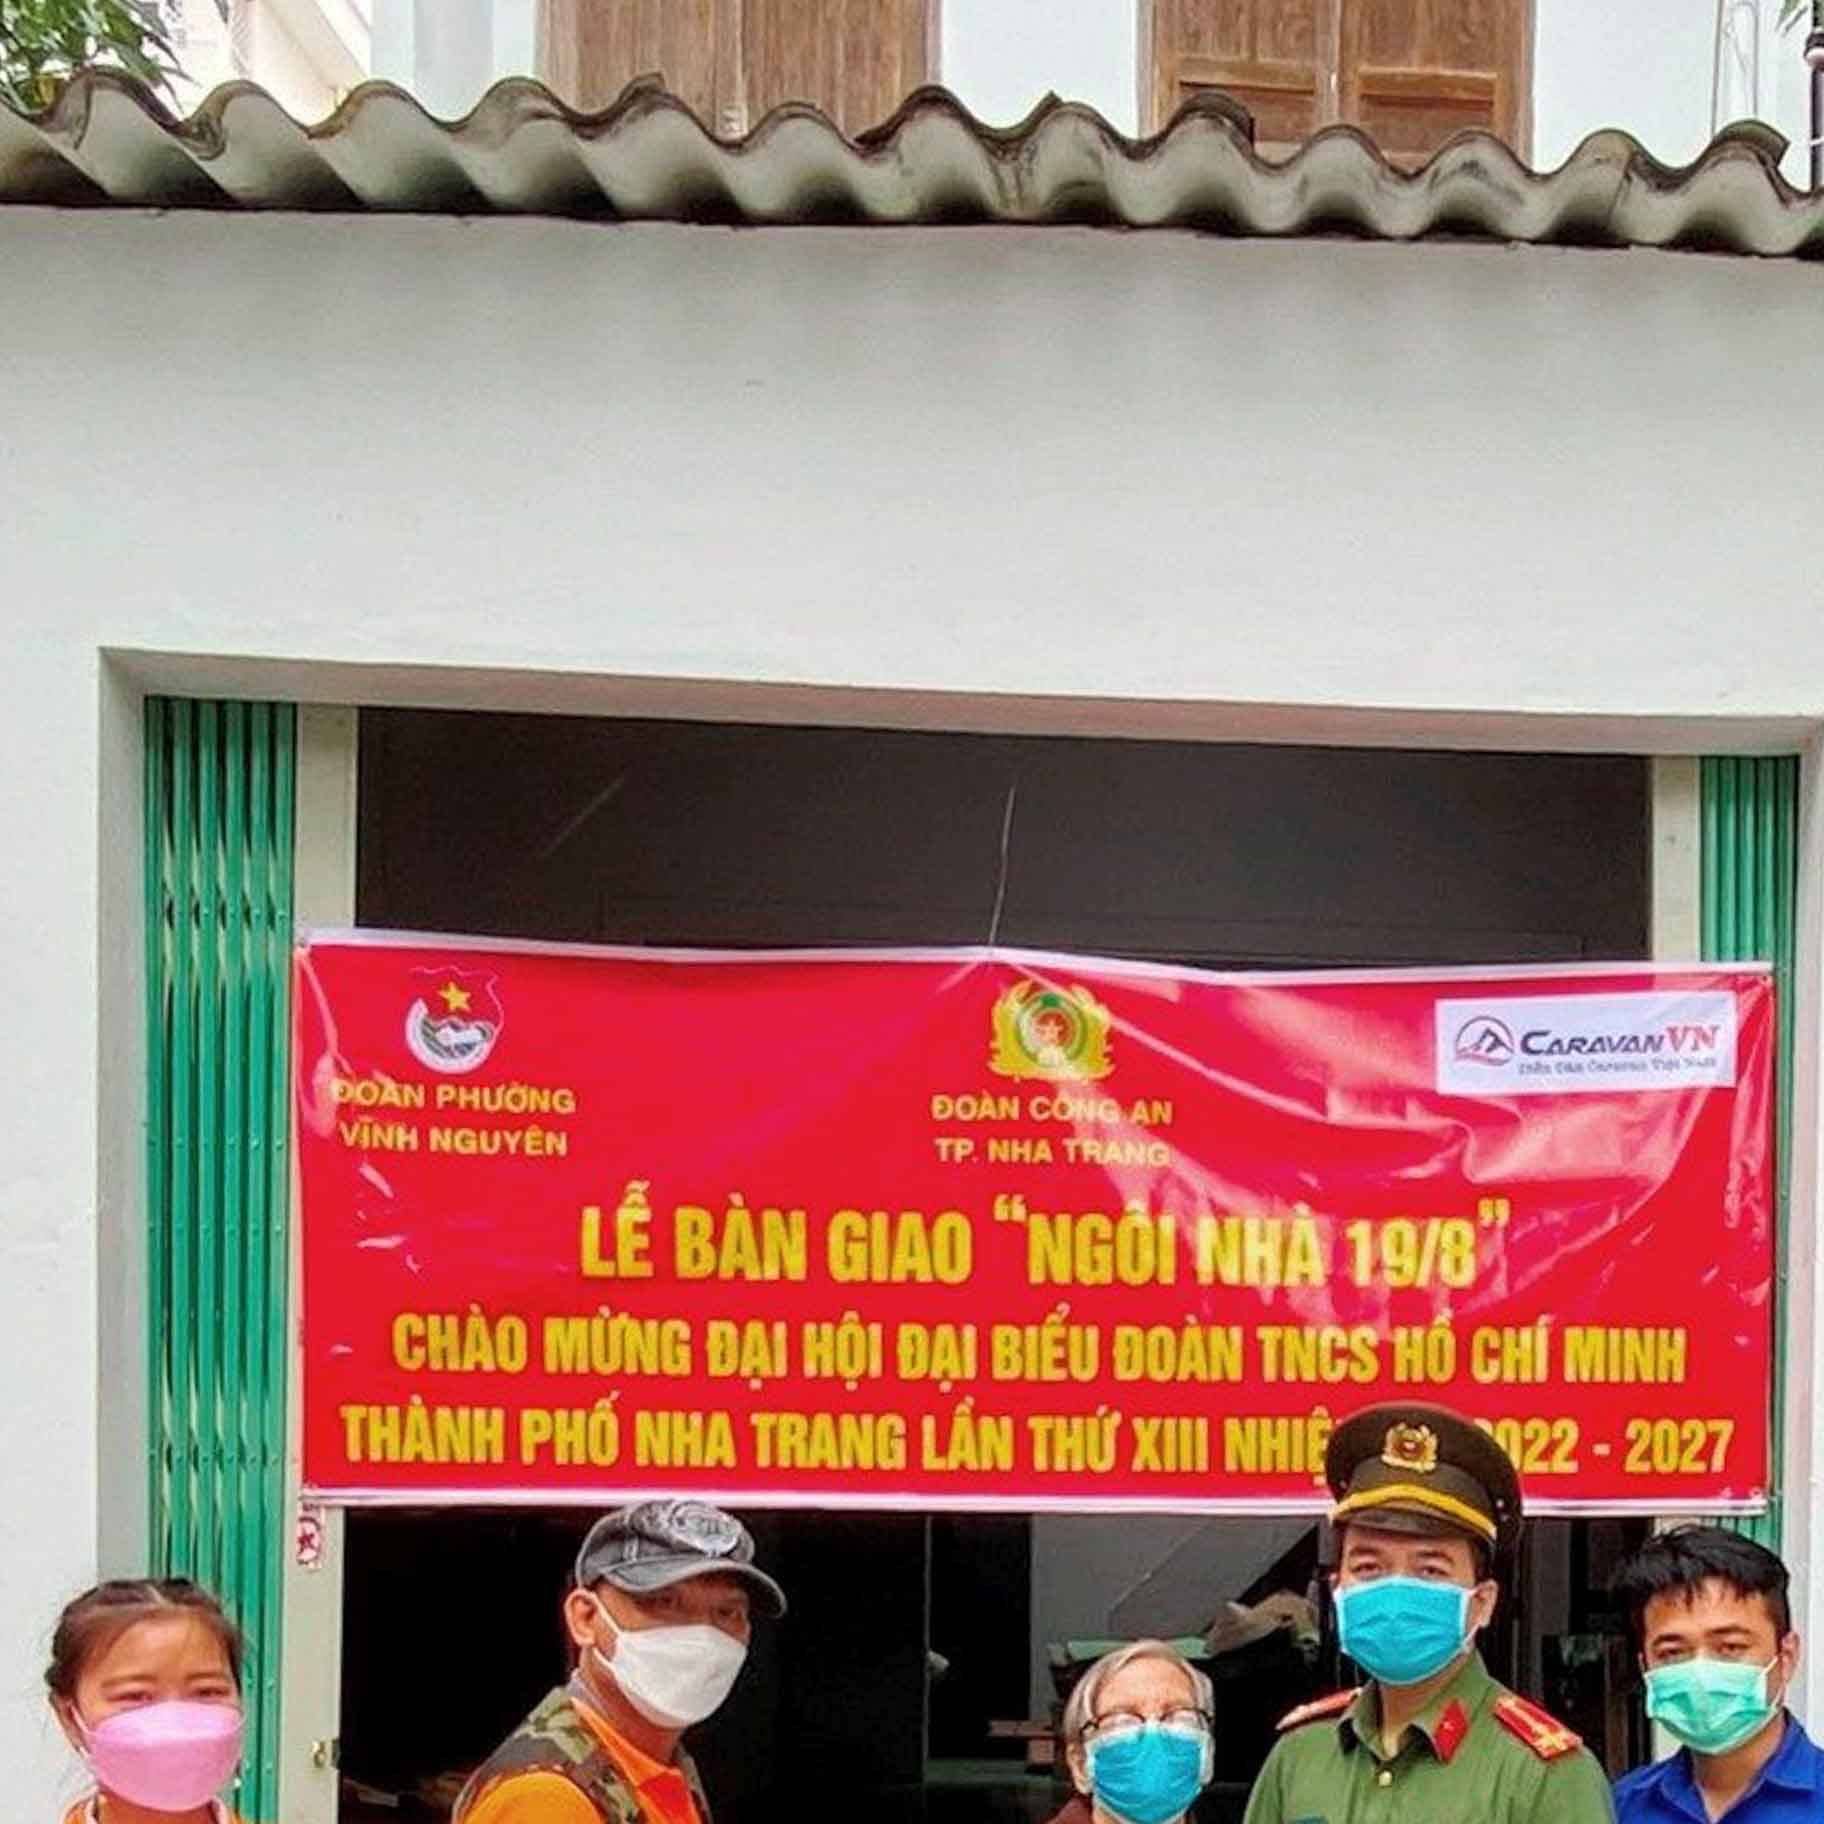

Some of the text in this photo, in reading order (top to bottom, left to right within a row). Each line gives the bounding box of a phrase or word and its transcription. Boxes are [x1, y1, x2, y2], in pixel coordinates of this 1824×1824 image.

[331, 1077, 576, 1114] ĐOÀN PHƯỜNG
[931, 1090, 1173, 1124] ĐOÀN CÔNG AN
[339, 1115, 567, 1156] VĨNH NGUYÊN
[934, 1137, 1171, 1166] TP. NHA TRANG
[581, 1181, 653, 1278] LỄ
[676, 1193, 806, 1281] BÀN
[828, 1210, 971, 1283] GIAO
[1197, 1203, 1326, 1287] NHÀ
[393, 1303, 1686, 1393] CHÀO MỪNG ĐẠI HỘI ĐẠI BIỂU ĐOÀN TNCS HỒ CHÍ MINH
[340, 1391, 1735, 1485] THÀNH PHỐ NHA TRANG LẦN THỨ XIII NHIỆ 022 - 2027
